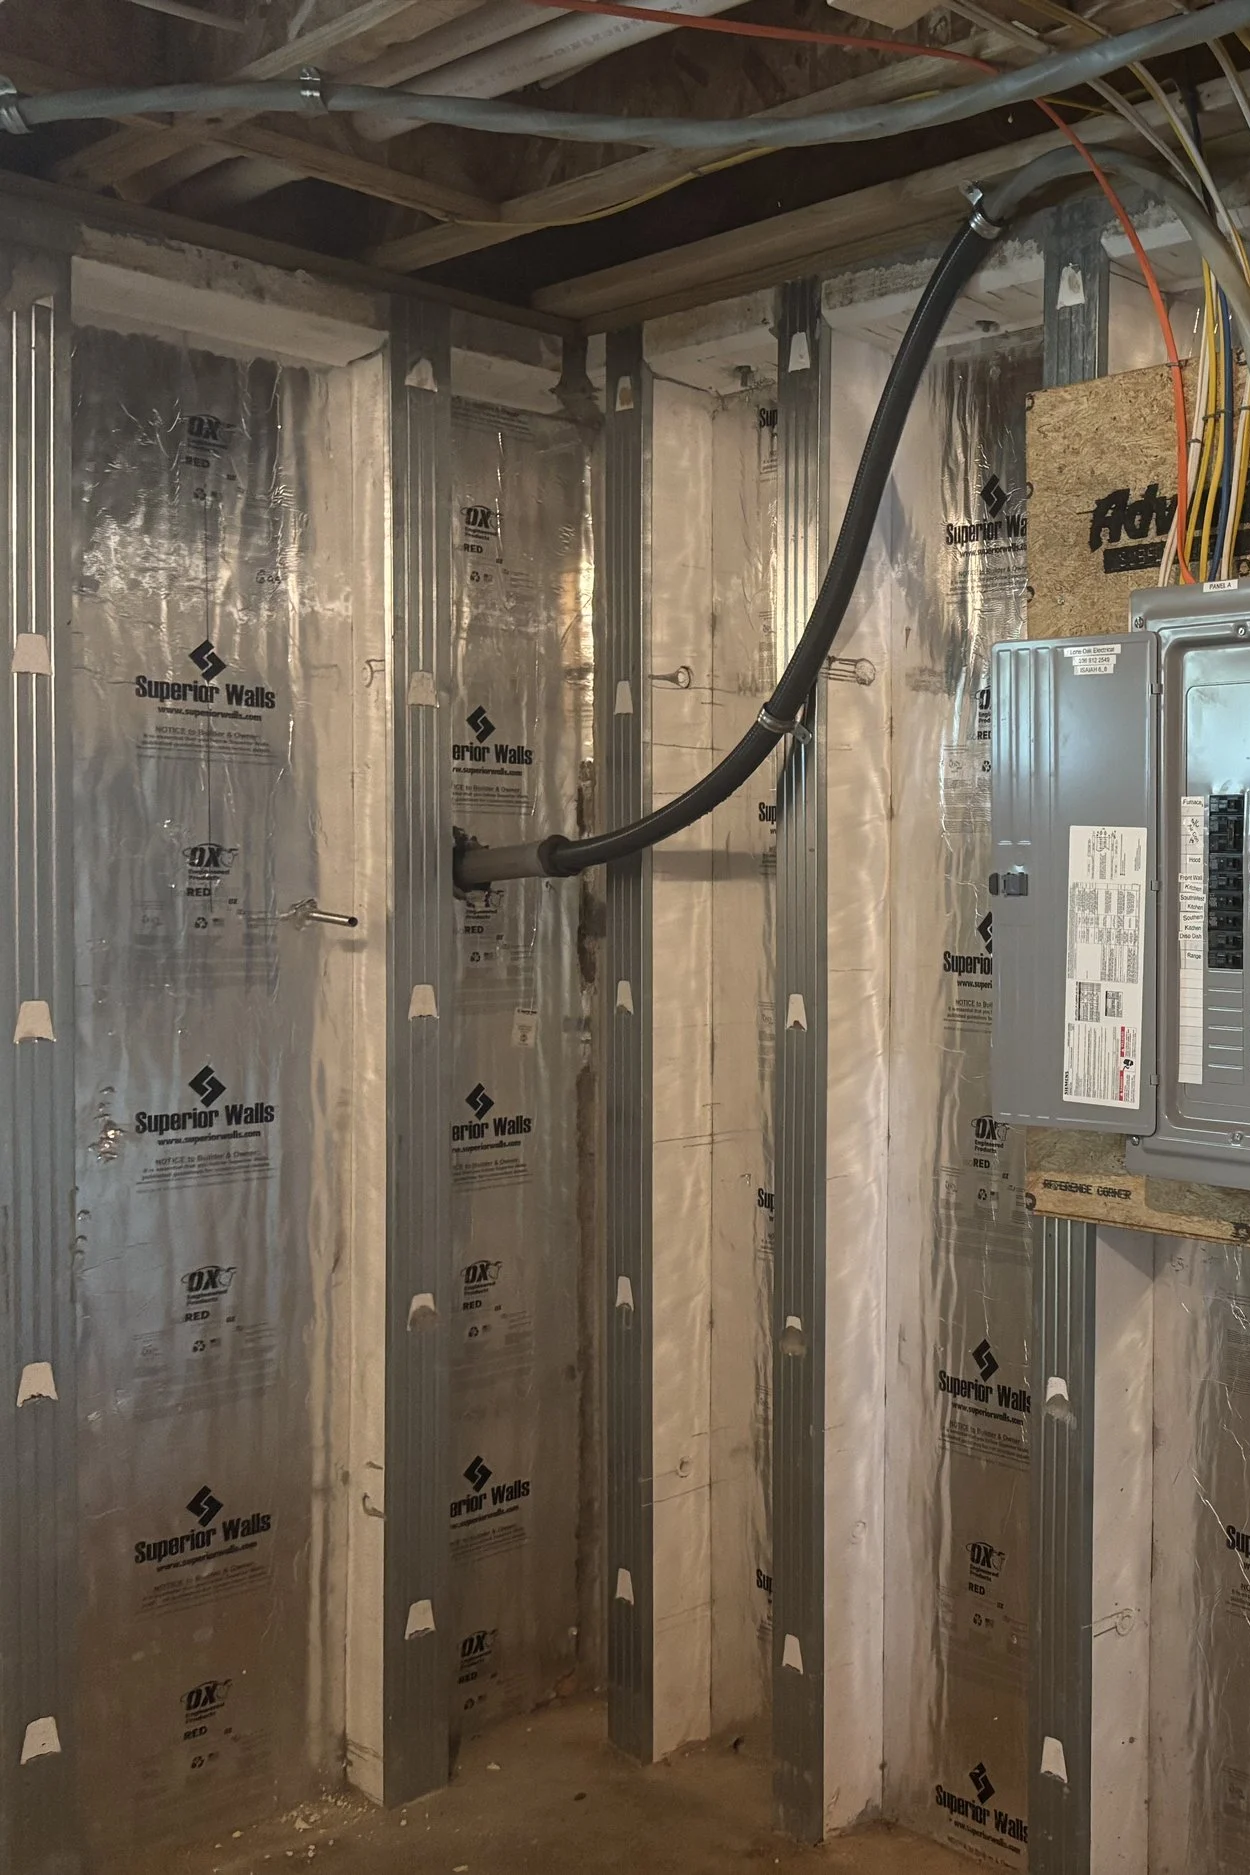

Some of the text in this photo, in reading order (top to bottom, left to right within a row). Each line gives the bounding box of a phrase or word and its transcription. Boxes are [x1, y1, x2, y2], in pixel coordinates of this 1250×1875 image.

[946, 518, 1002, 547] Superior
[464, 543, 483, 553] RED
[1209, 582, 1226, 591] PANEL
[135, 675, 276, 709] Superior Walls
[495, 744, 533, 765] Walls
[187, 888, 212, 896] RED
[465, 925, 484, 934] RED
[135, 1102, 275, 1135] Superior Walls
[493, 1115, 532, 1136] Walls
[973, 1158, 990, 1168] RED
[463, 1300, 482, 1311] RED
[185, 1311, 210, 1322] RED
[939, 1370, 1031, 1413] Superior Walls
[491, 1479, 530, 1505] Walls
[134, 1512, 271, 1563] Superior Walls
[969, 1582, 985, 1595] RED
[935, 1784, 990, 1825] Superior
